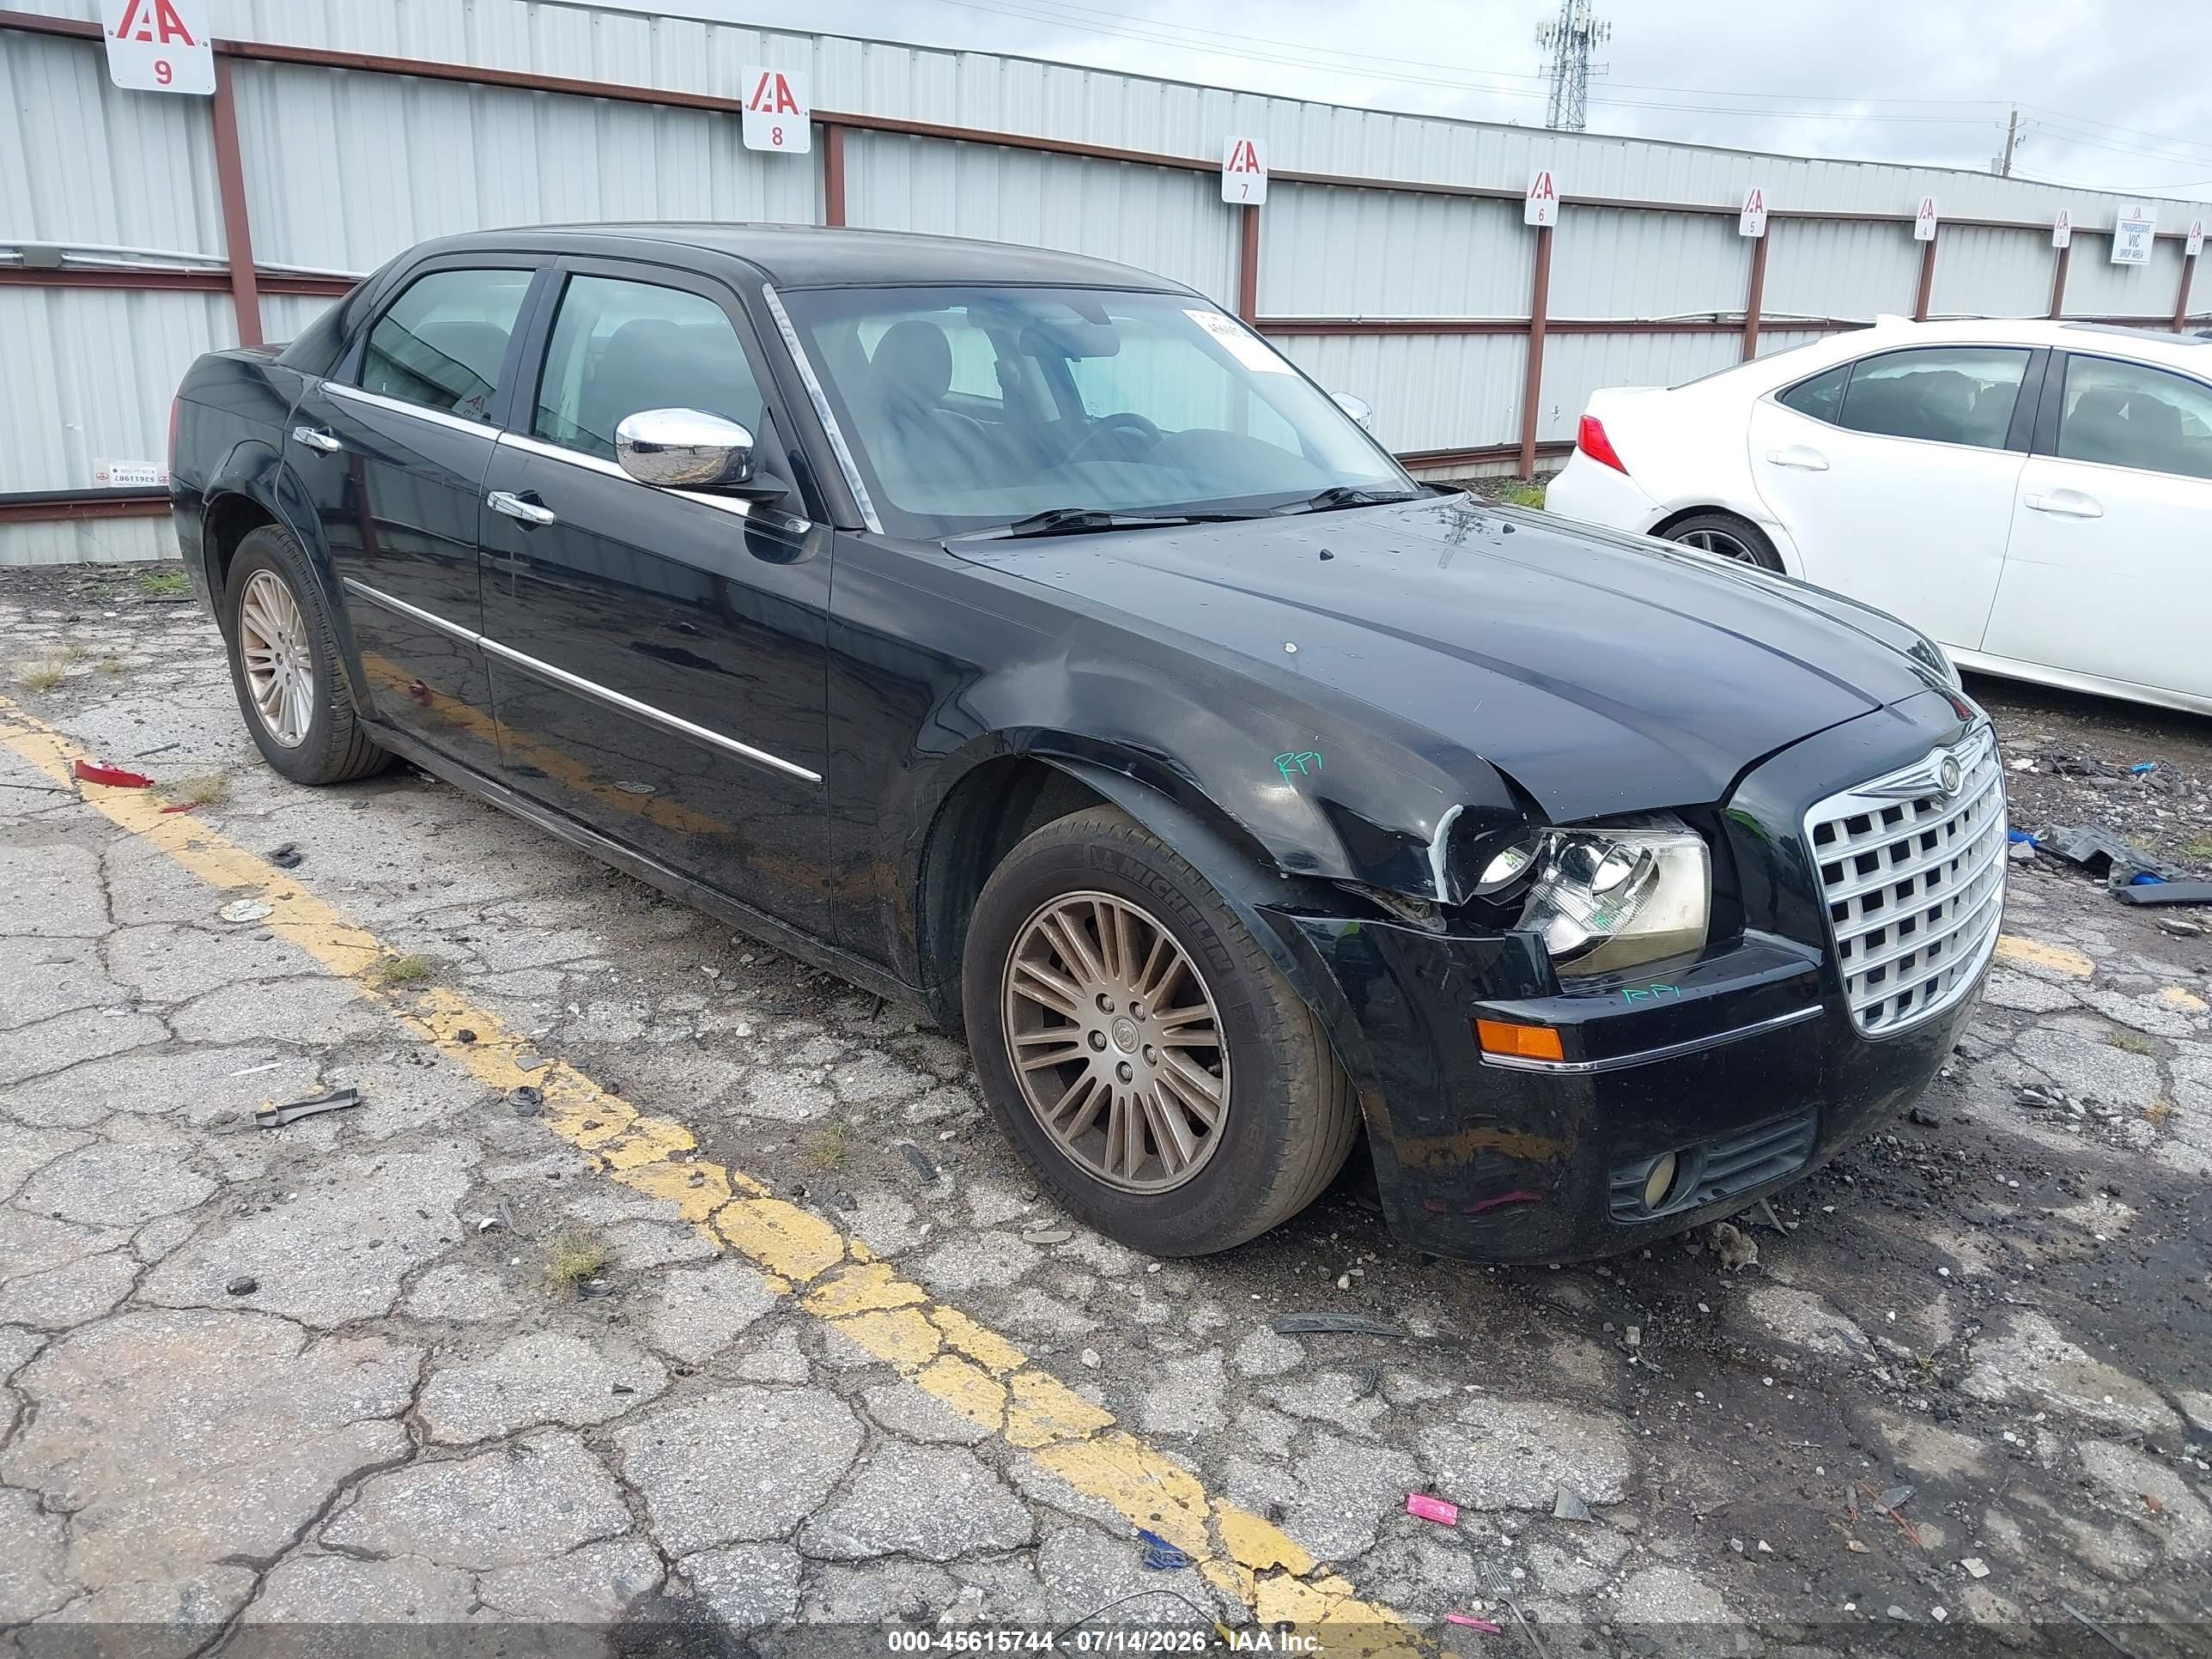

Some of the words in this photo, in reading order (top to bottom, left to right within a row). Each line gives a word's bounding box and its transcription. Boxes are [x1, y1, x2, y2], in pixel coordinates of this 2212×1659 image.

[154, 59, 173, 85] 9
[772, 126, 783, 146] 8
[1241, 183, 1249, 199] 7
[1538, 208, 1546, 222] 6
[1749, 221, 1756, 234] 5
[2129, 233, 2142, 248] VIC
[1118, 857, 1236, 970] MICHELIN
